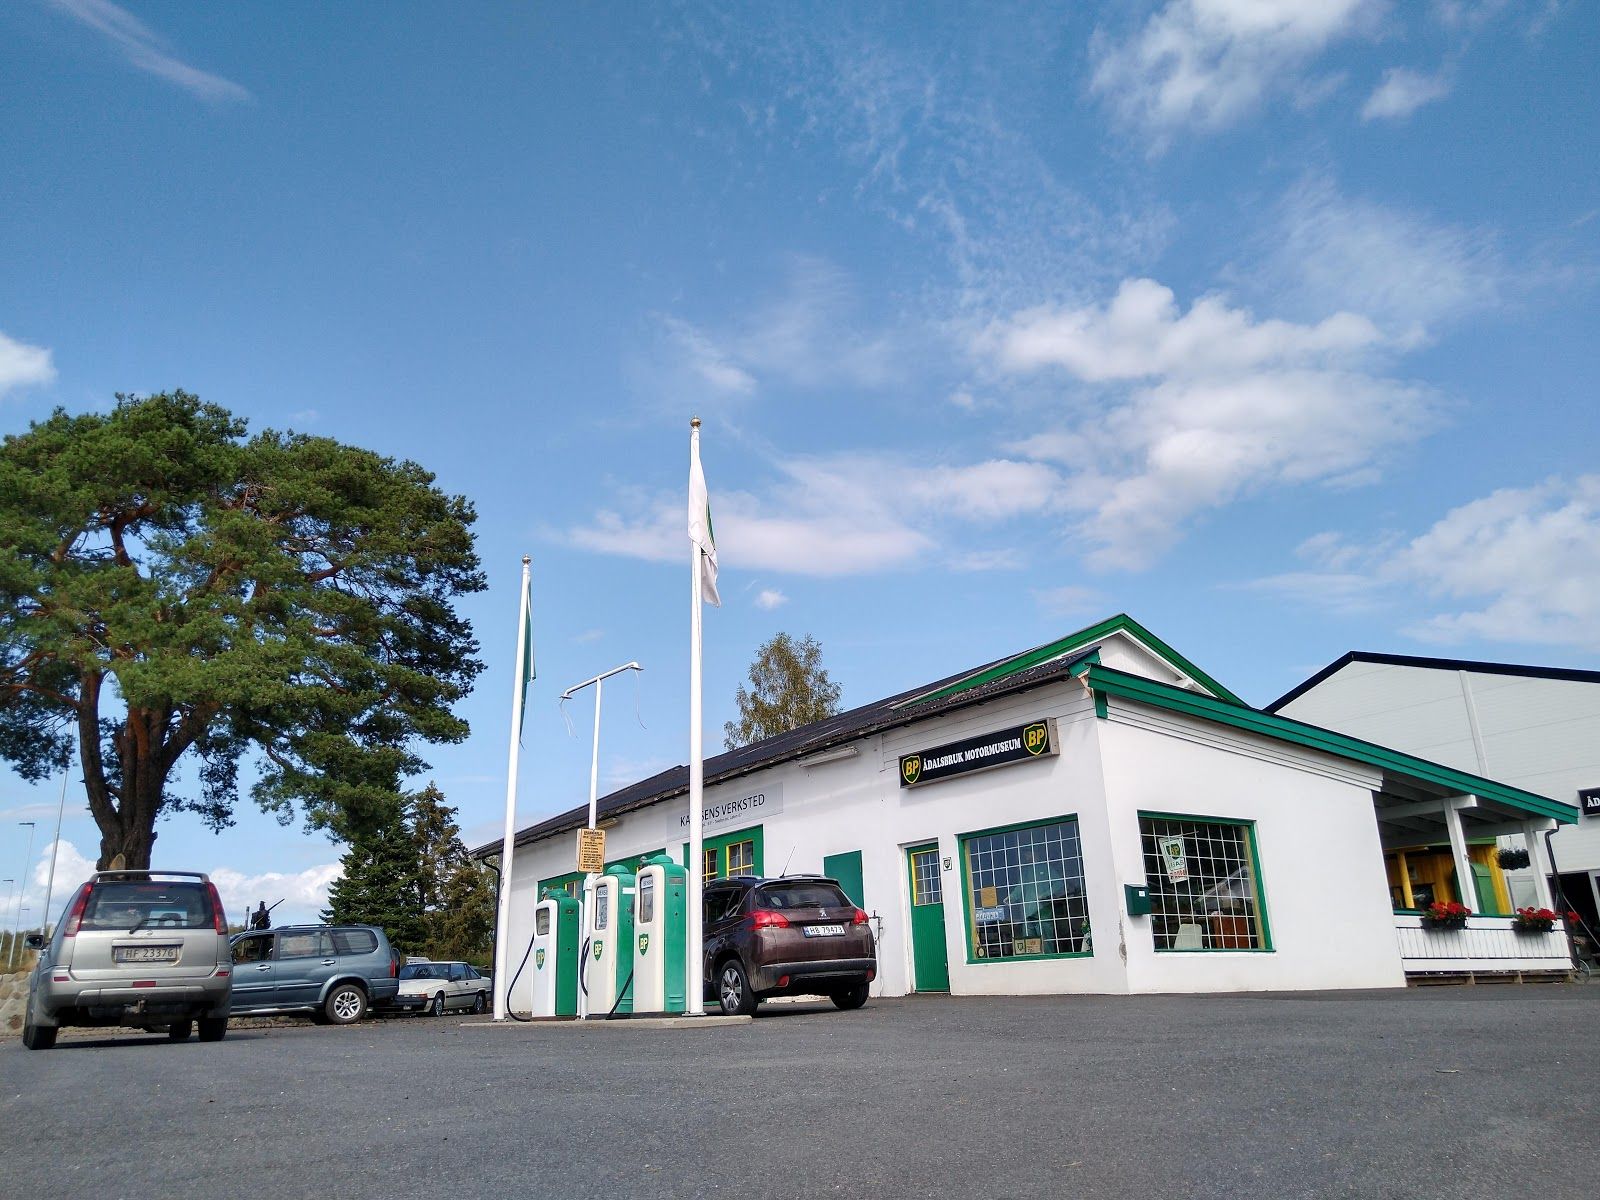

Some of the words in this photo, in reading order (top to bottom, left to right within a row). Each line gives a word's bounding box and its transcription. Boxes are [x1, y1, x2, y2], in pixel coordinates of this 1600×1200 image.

[905, 760, 919, 776] BP
[923, 752, 964, 771] ÅDALSBRUK
[964, 737, 1022, 762] MOTORMUSEUM
[1027, 728, 1046, 747] BP
[680, 806, 720, 827] KASENS
[721, 793, 765, 816] VERKSTED
[821, 926, 843, 934] 79473
[595, 943, 602, 955] BP
[639, 937, 648, 950] BP
[125, 949, 139, 958] HF
[142, 948, 174, 958] 23376
